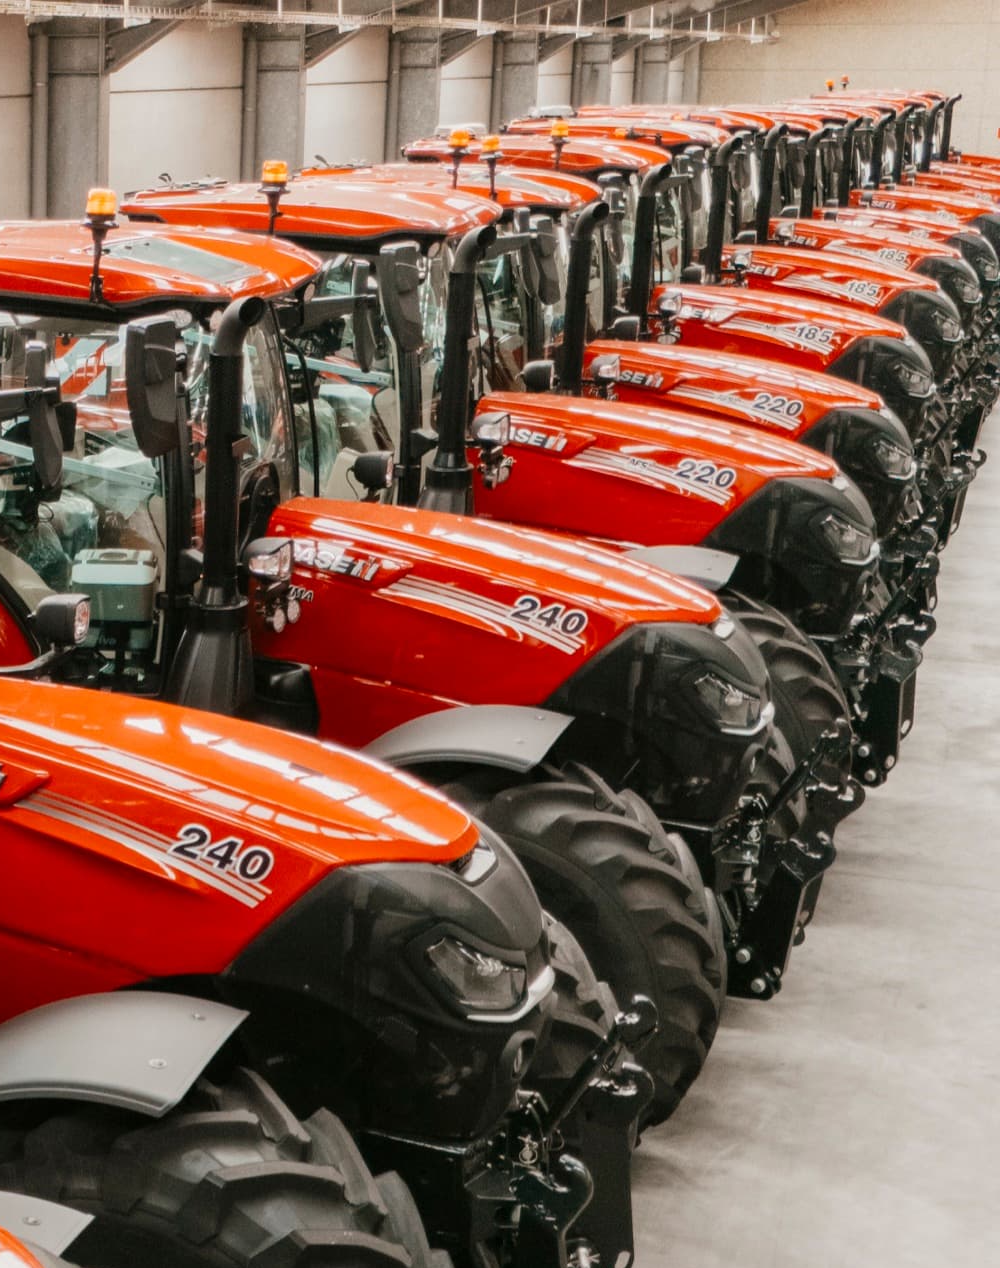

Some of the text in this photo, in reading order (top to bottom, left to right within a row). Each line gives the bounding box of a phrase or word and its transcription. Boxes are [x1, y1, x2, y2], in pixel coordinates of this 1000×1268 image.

[877, 247, 907, 263] 185
[846, 280, 878, 297] 185
[795, 324, 834, 344] 185
[752, 392, 804, 418] 220
[673, 459, 737, 490] 220
[509, 593, 589, 637] 240
[168, 822, 276, 884] 240
